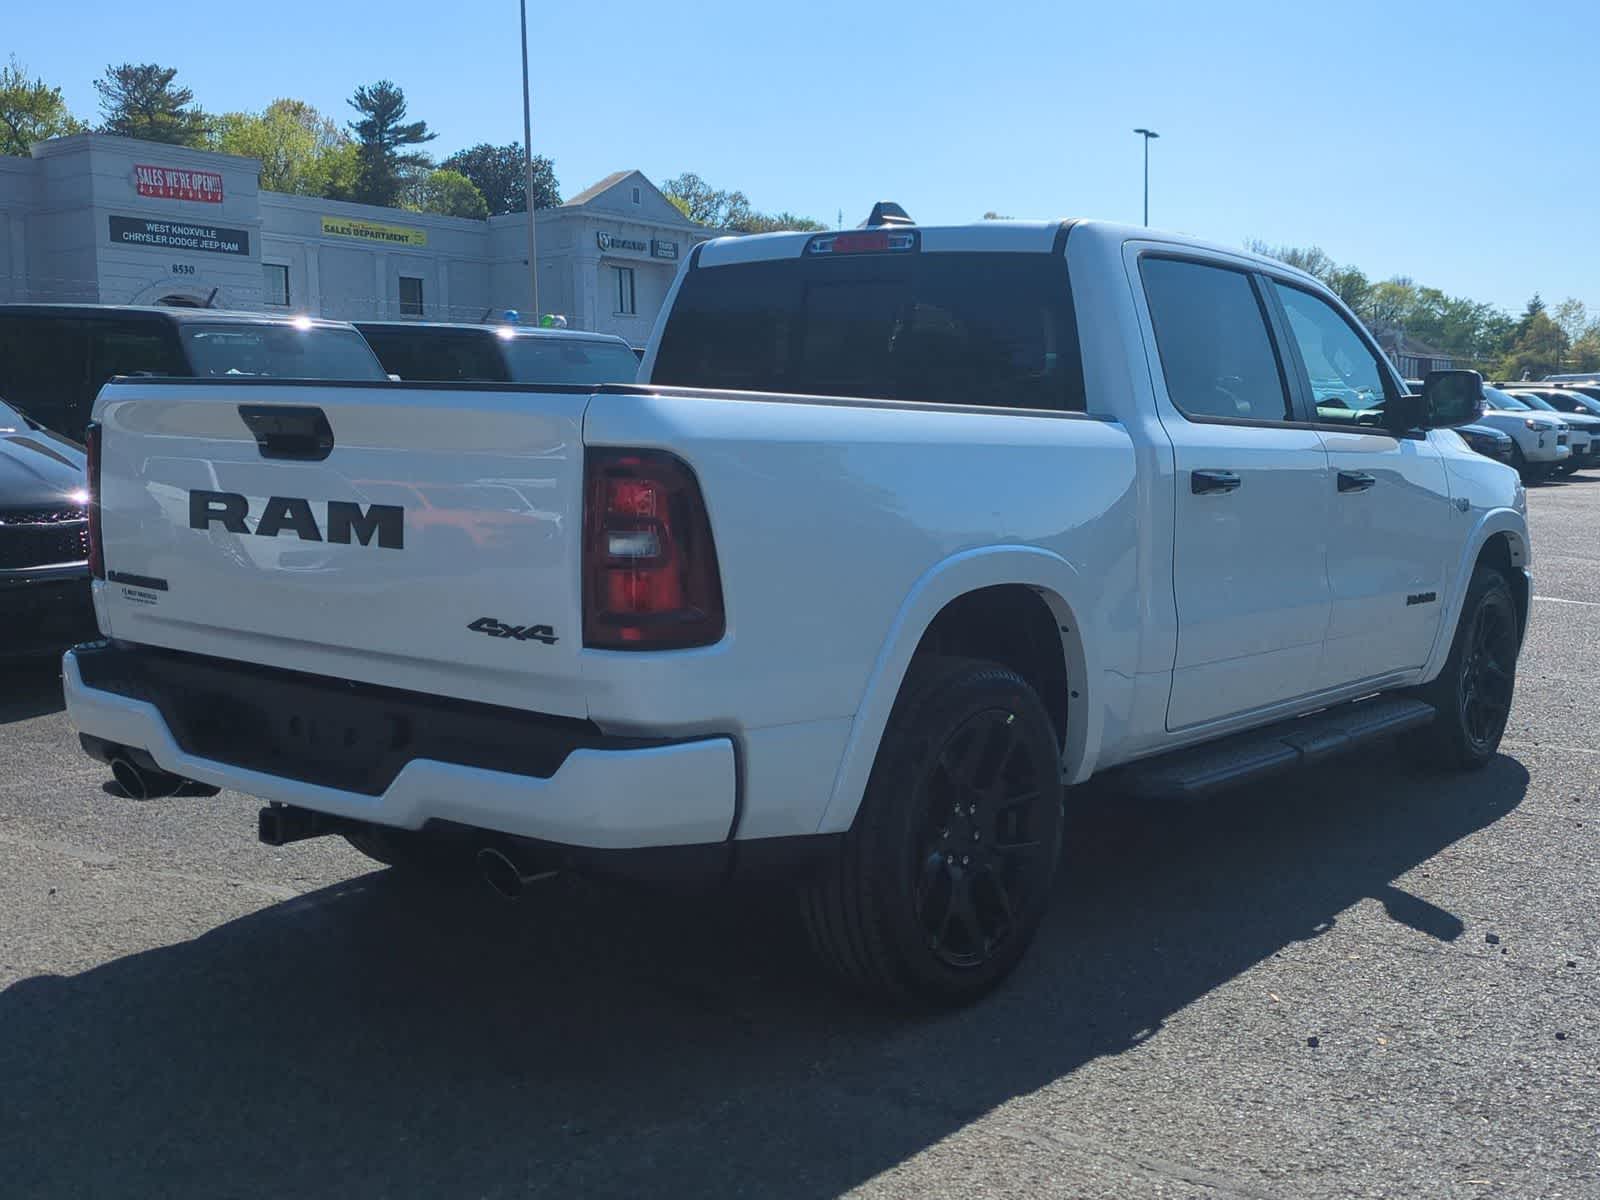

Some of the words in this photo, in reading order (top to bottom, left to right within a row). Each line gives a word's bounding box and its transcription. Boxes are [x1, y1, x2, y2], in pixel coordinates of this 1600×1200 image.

[136, 167, 163, 186] SALES
[164, 171, 190, 190] WE'RE
[192, 174, 222, 193] OPEN!!!
[146, 223, 170, 233] WEST
[171, 225, 217, 239] KNOXVILLE
[323, 224, 352, 236] SALES
[353, 228, 409, 242] DEPARTMENT
[122, 231, 167, 244] CHRYSLER
[169, 236, 199, 248] DODGE
[199, 239, 220, 250] JEEP
[221, 241, 239, 251] RAM
[172, 264, 195, 275] 8530
[189, 489, 404, 550] RAM
